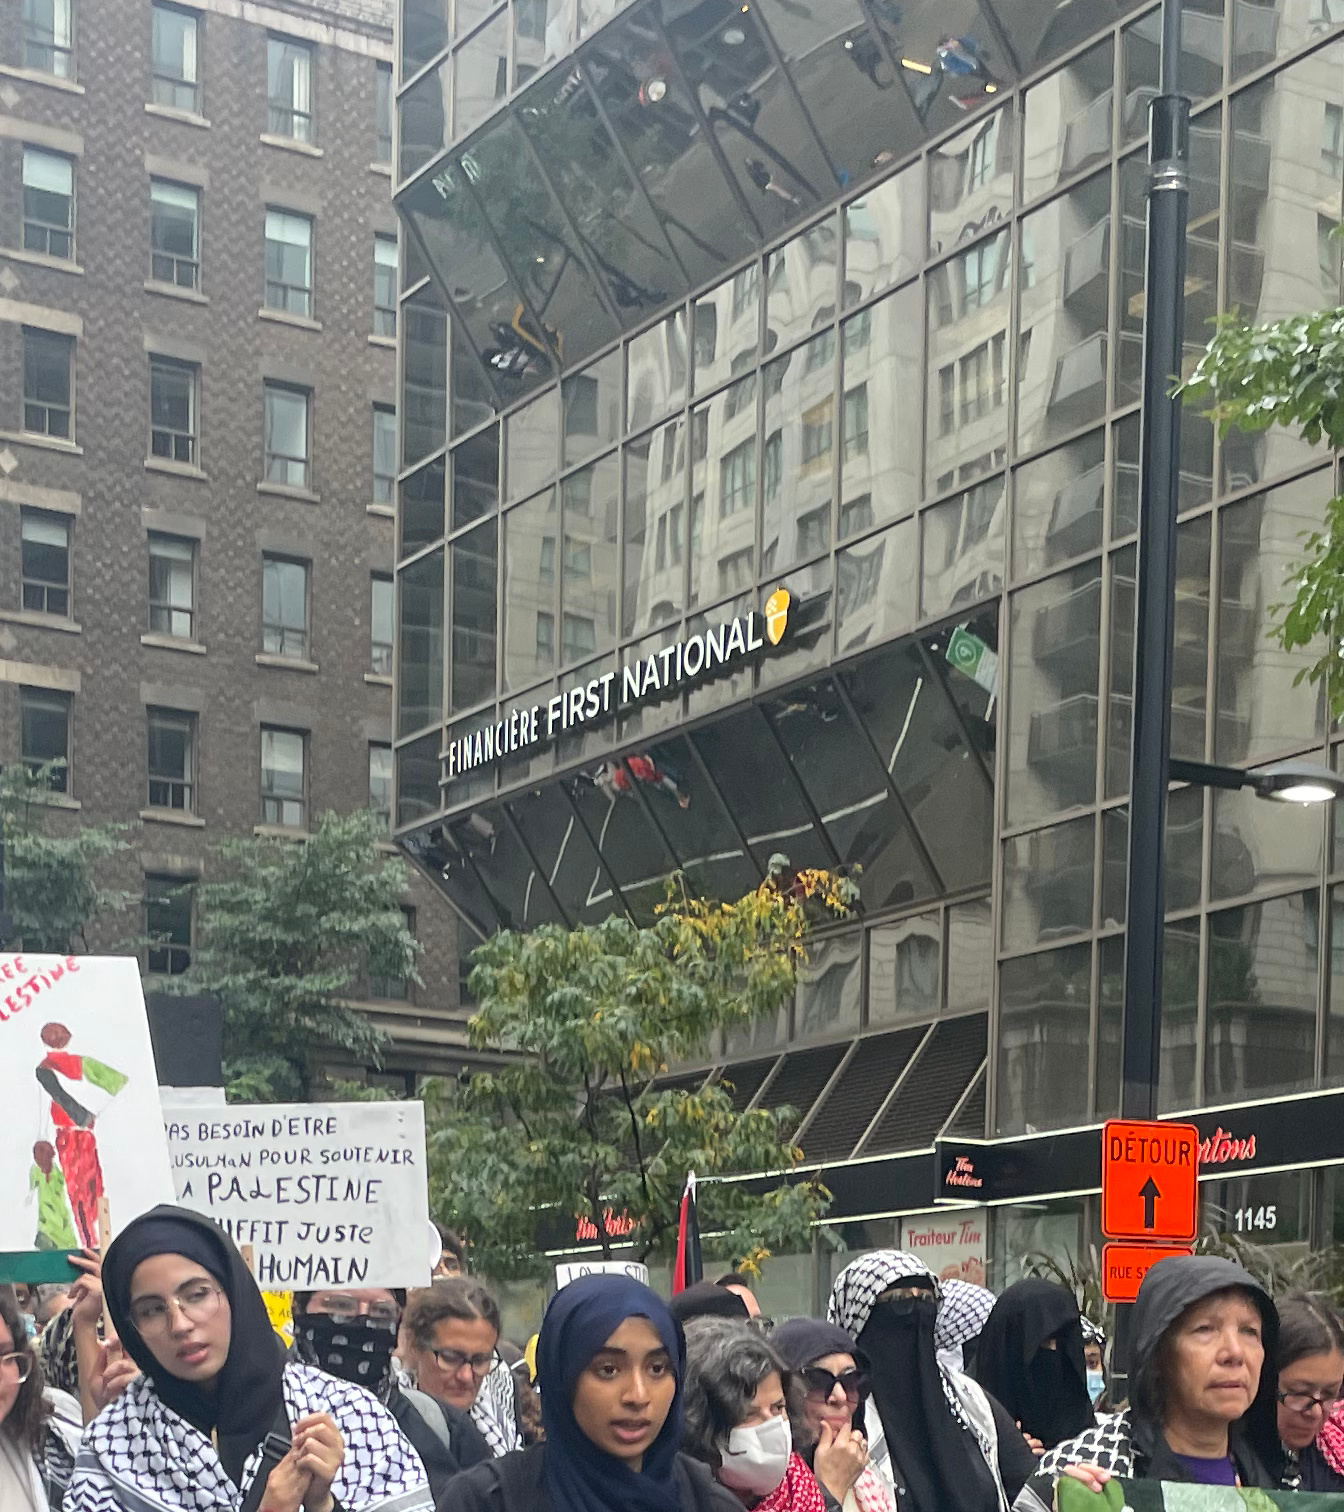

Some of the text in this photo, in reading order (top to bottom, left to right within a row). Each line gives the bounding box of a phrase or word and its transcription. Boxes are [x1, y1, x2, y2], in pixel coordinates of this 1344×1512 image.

[449, 610, 765, 777] FINANCIÈRE FIRST NATIONAL
[165, 1114, 337, 1142] AS BESOIN D'ETRE
[171, 1146, 415, 1168] USULMaN POUR SOUTENIR
[1110, 1131, 1191, 1167] DÉTOUR
[208, 1172, 383, 1205] PALESTINE
[214, 1217, 289, 1245] UFFIT
[1235, 1205, 1277, 1232] 1145
[907, 1219, 981, 1248] Traiteur Tim
[259, 1253, 369, 1286] HUMAIN
[1110, 1266, 1133, 1280] RUE
